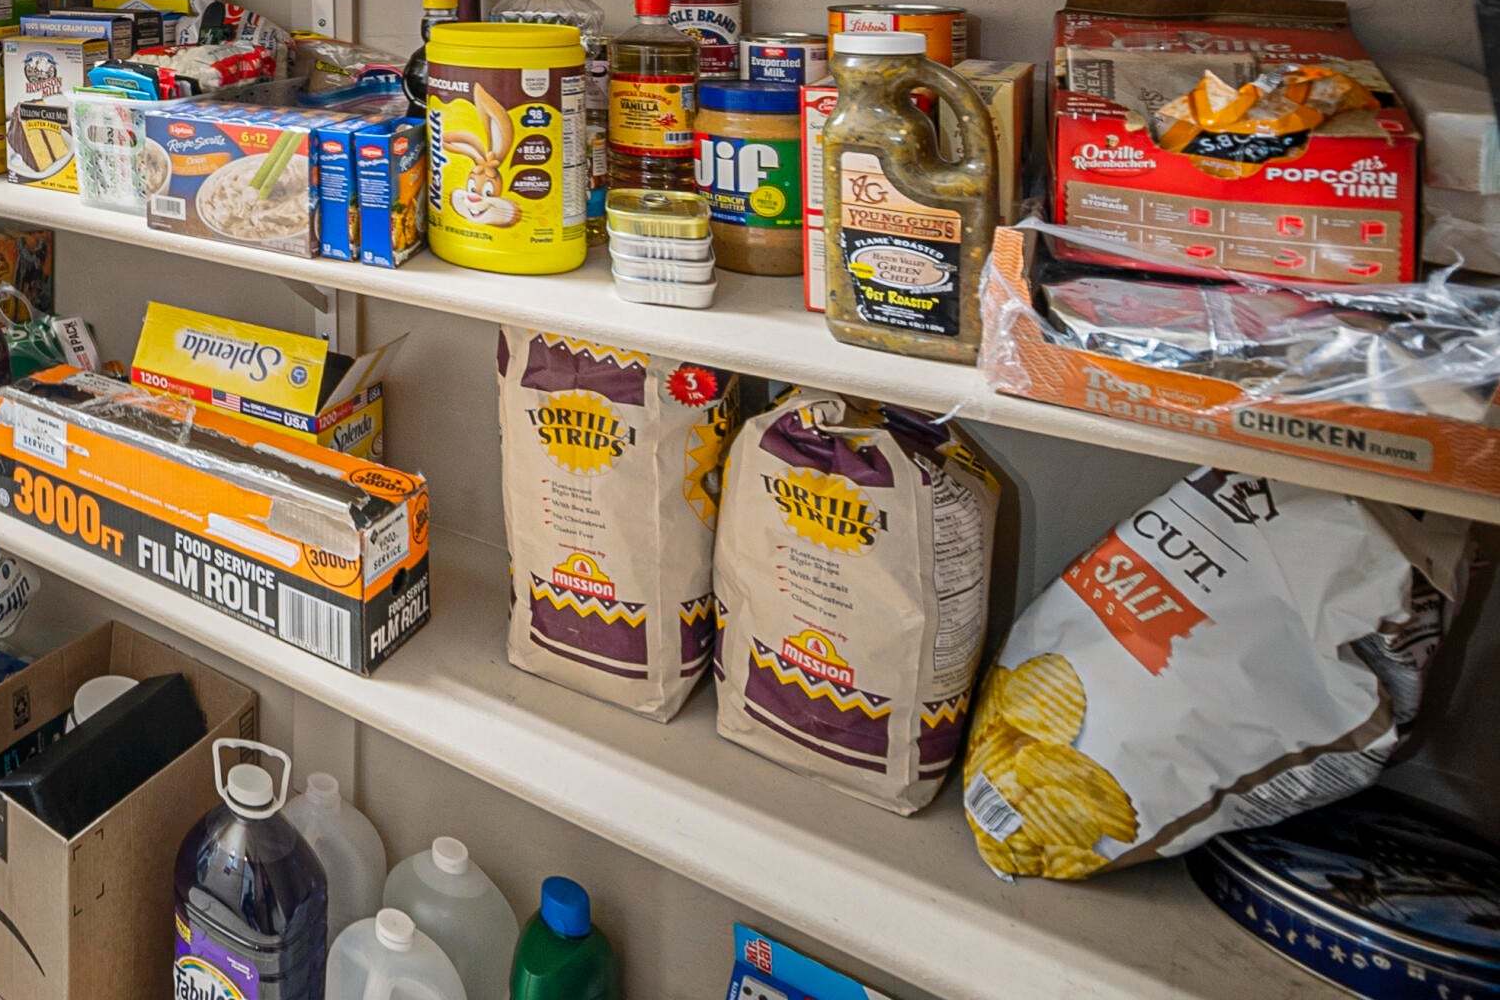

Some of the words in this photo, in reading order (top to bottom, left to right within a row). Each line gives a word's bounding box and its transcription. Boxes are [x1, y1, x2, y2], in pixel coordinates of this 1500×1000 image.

[698, 9, 737, 34] BRAND
[751, 57, 801, 68] Evaporated
[763, 67, 786, 77] Milk
[26, 78, 62, 93] HODGSON
[1087, 62, 1100, 96] REAL
[42, 87, 61, 97] MILL
[529, 109, 542, 119] 98
[620, 102, 659, 112] VANILLA
[429, 110, 449, 210] Nesquik
[524, 146, 546, 154] REAL
[1081, 143, 1144, 160] Orville
[694, 139, 780, 193] Jif
[1072, 155, 1157, 169] Redenbacher's
[1266, 168, 1398, 185] POPCORN
[1331, 183, 1398, 198] TIME
[848, 208, 903, 226] YOUNG
[906, 216, 955, 239] GUNS
[855, 238, 889, 248] FLAME
[893, 239, 944, 260] ROASTED
[877, 261, 922, 276] GREEN
[879, 271, 919, 285] CHILE
[63, 321, 81, 344] PACK
[182, 332, 282, 382] Splenda
[140, 371, 168, 390] 1200
[684, 373, 699, 391] 3
[1083, 367, 1151, 400] Top
[319, 411, 337, 430] 1200
[1086, 388, 1219, 435] Ramen
[283, 415, 309, 432] USA
[332, 414, 372, 454] Splenda
[525, 407, 637, 447] TORTILLA
[23, 435, 55, 456] SERVICE
[538, 427, 626, 457] STRIPS
[1238, 410, 1367, 452] CHICKEN
[1369, 443, 1418, 463] FLAVOR
[760, 474, 890, 532] TORTILLA
[775, 496, 876, 546] STRIPS
[175, 531, 212, 563] FOOD
[214, 544, 275, 591] SERVICE
[373, 543, 402, 571] SERVICE
[138, 535, 199, 593] FILM
[204, 561, 276, 628] ROLL
[1094, 554, 1184, 622] SALT
[388, 596, 405, 619] FOOD
[370, 613, 399, 660] FILM
[401, 591, 429, 633] ROLL
